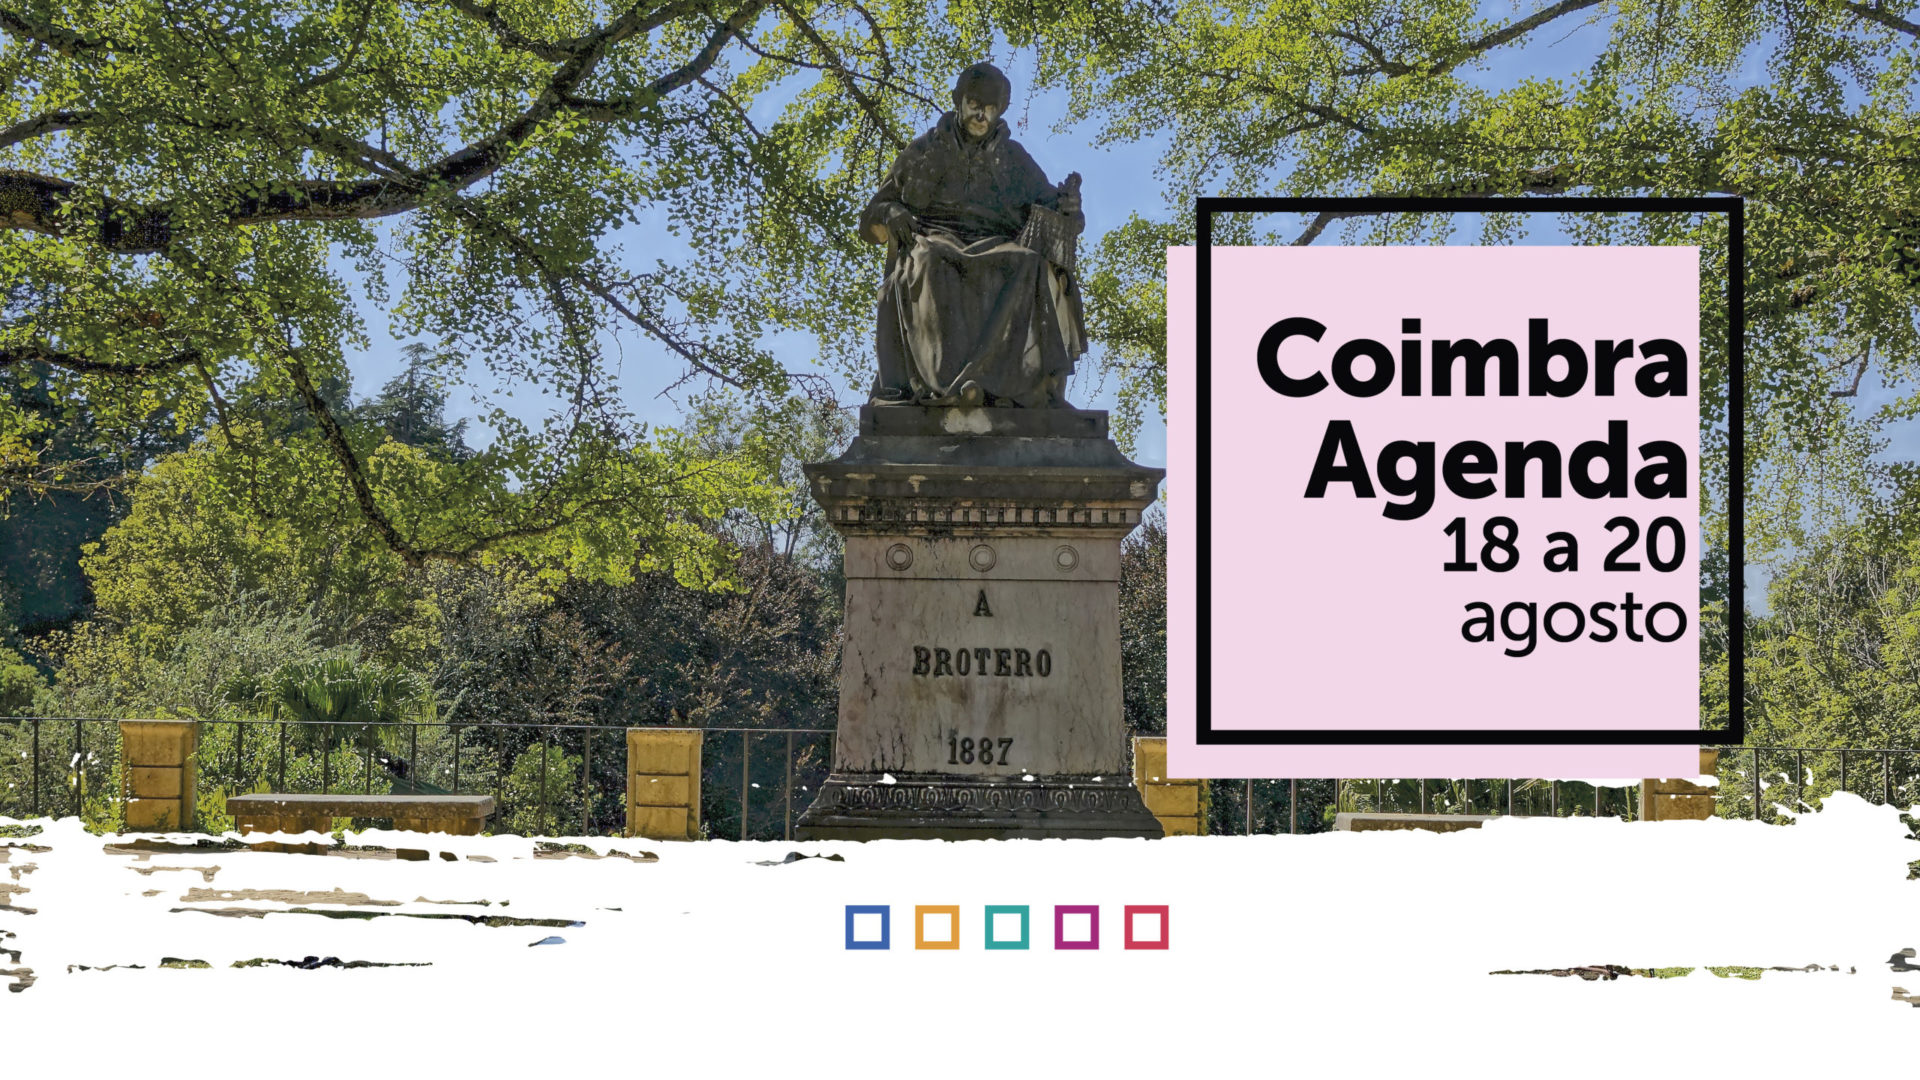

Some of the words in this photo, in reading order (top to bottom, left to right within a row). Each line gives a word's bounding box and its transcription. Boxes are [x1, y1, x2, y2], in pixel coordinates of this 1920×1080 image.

[973, 589, 994, 617] A
[912, 645, 1052, 678] BROTERO
[947, 737, 1014, 766] 1887
